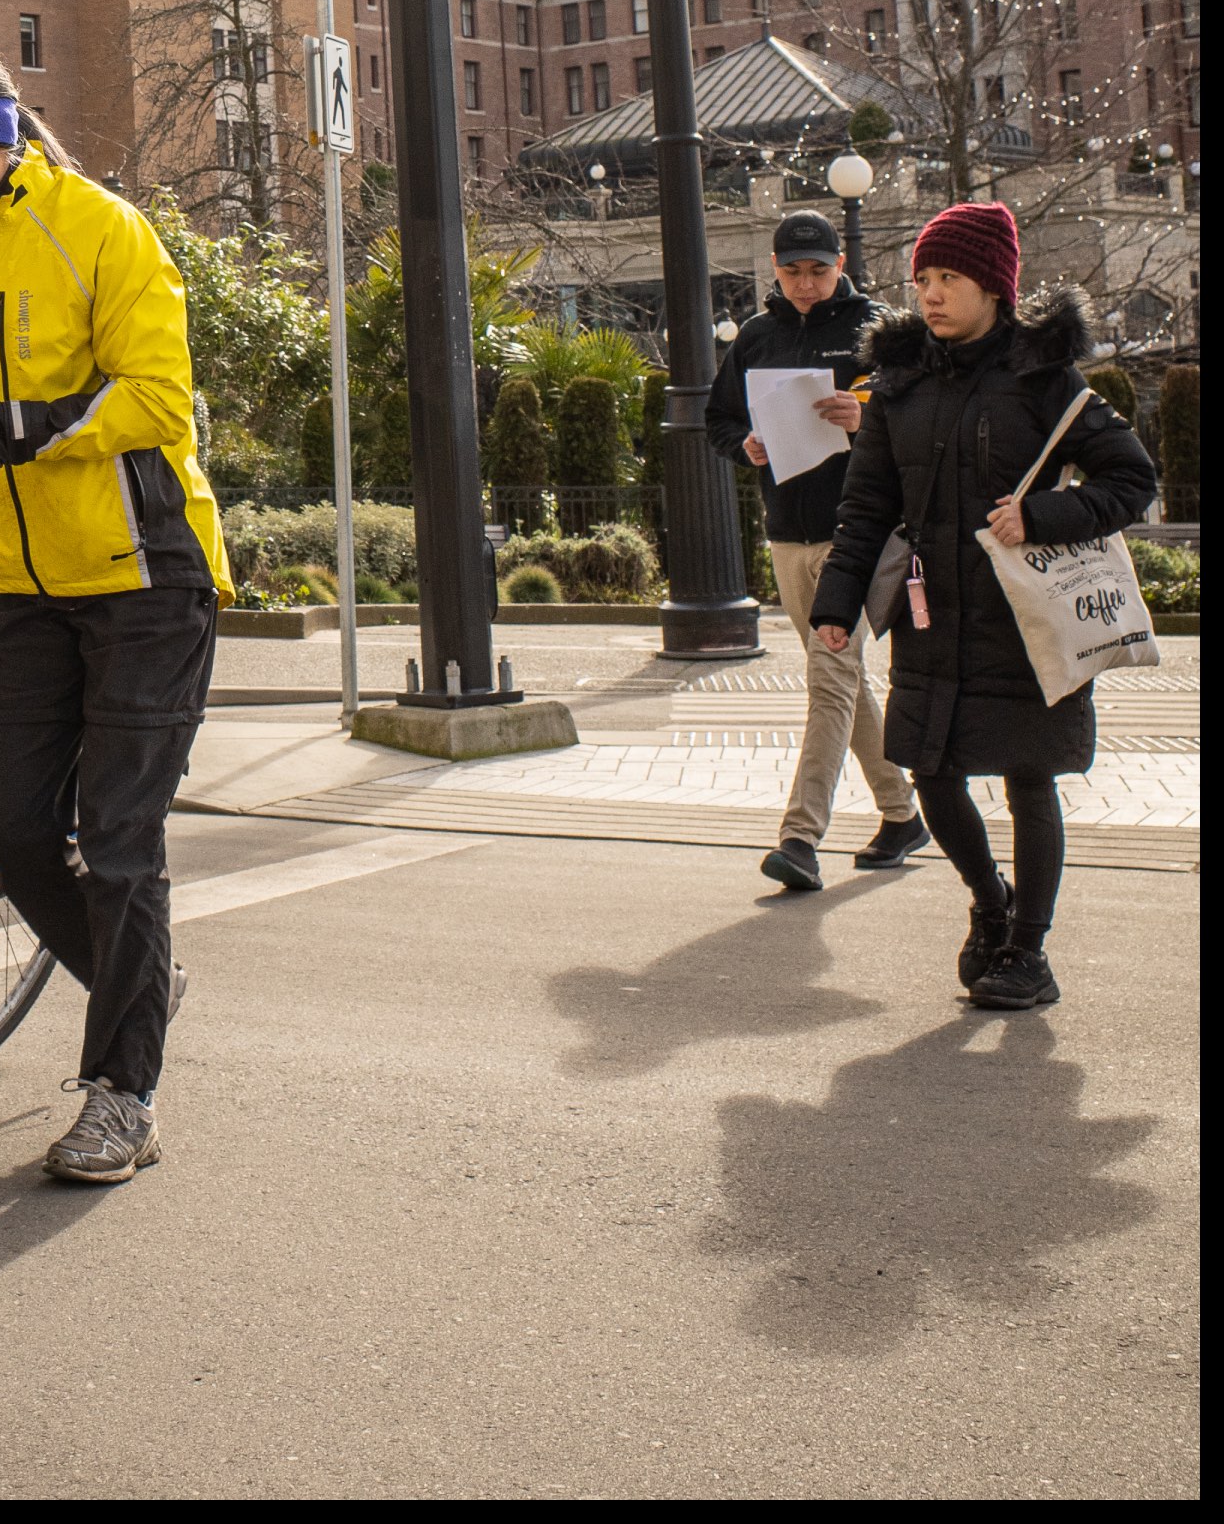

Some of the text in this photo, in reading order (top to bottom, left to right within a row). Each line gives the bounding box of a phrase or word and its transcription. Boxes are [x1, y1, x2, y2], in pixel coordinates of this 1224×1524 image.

[15, 289, 33, 360] showers pass
[1076, 648, 1093, 661] SALT
[1094, 639, 1120, 654] SPRING
